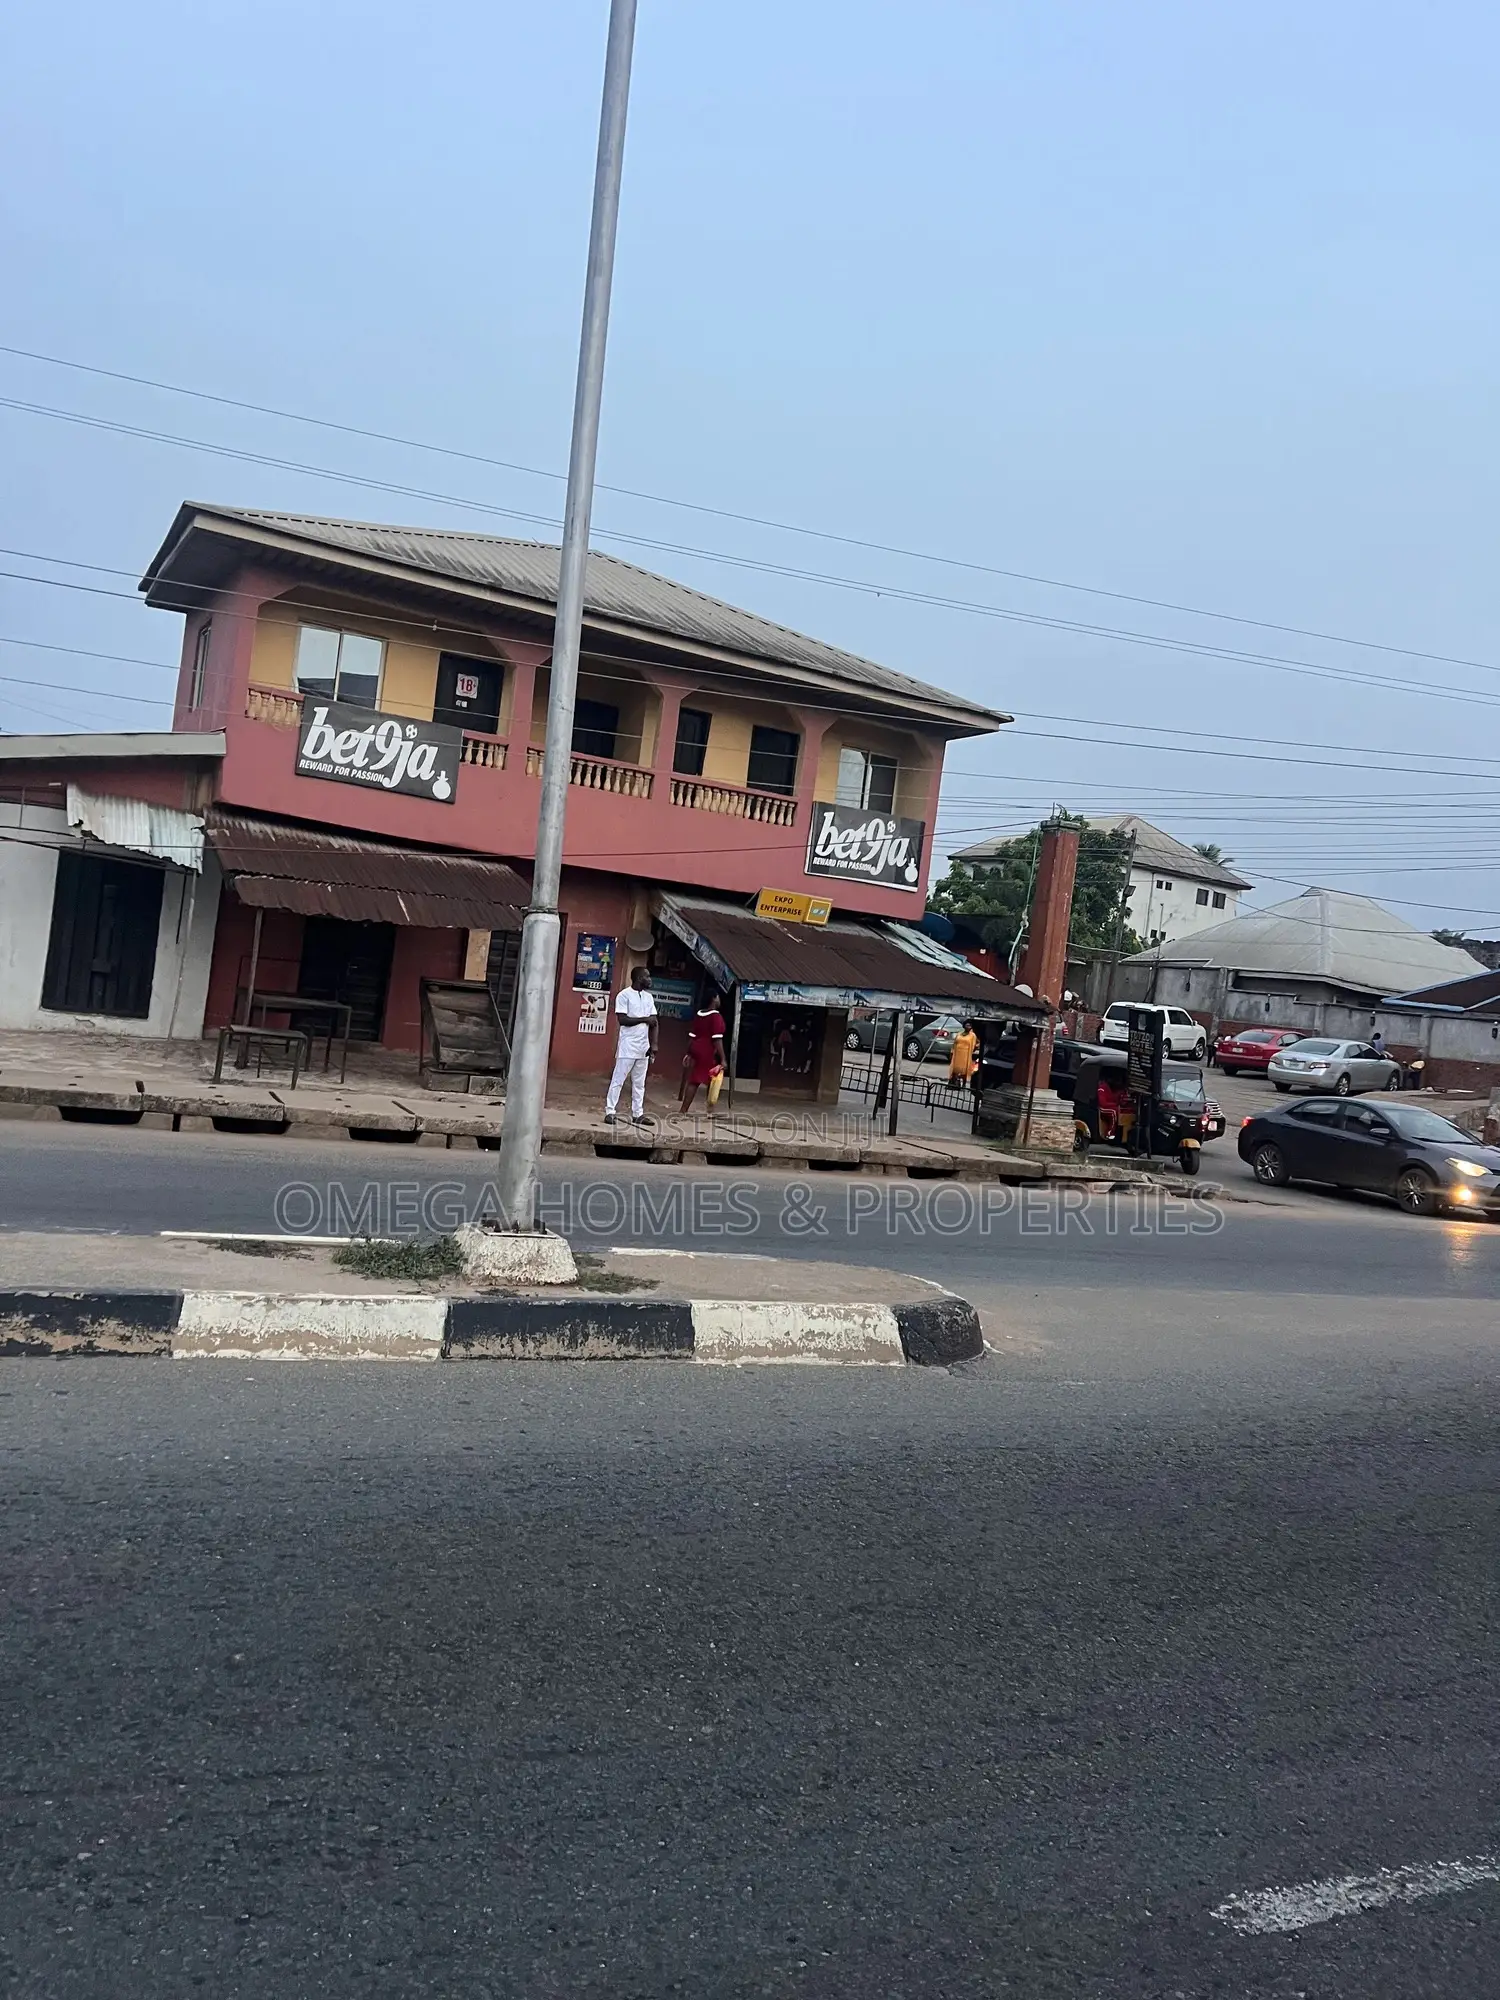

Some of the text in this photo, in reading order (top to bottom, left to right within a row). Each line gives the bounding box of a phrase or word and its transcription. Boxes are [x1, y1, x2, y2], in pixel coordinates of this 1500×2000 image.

[301, 706, 439, 788] bet9ja
[299, 759, 385, 783] REWARD FOR PASSION
[815, 811, 910, 876] bet9ja
[812, 857, 836, 867] REWARD
[836, 860, 848, 868] FOR
[760, 903, 803, 916] ENTERPRISE
